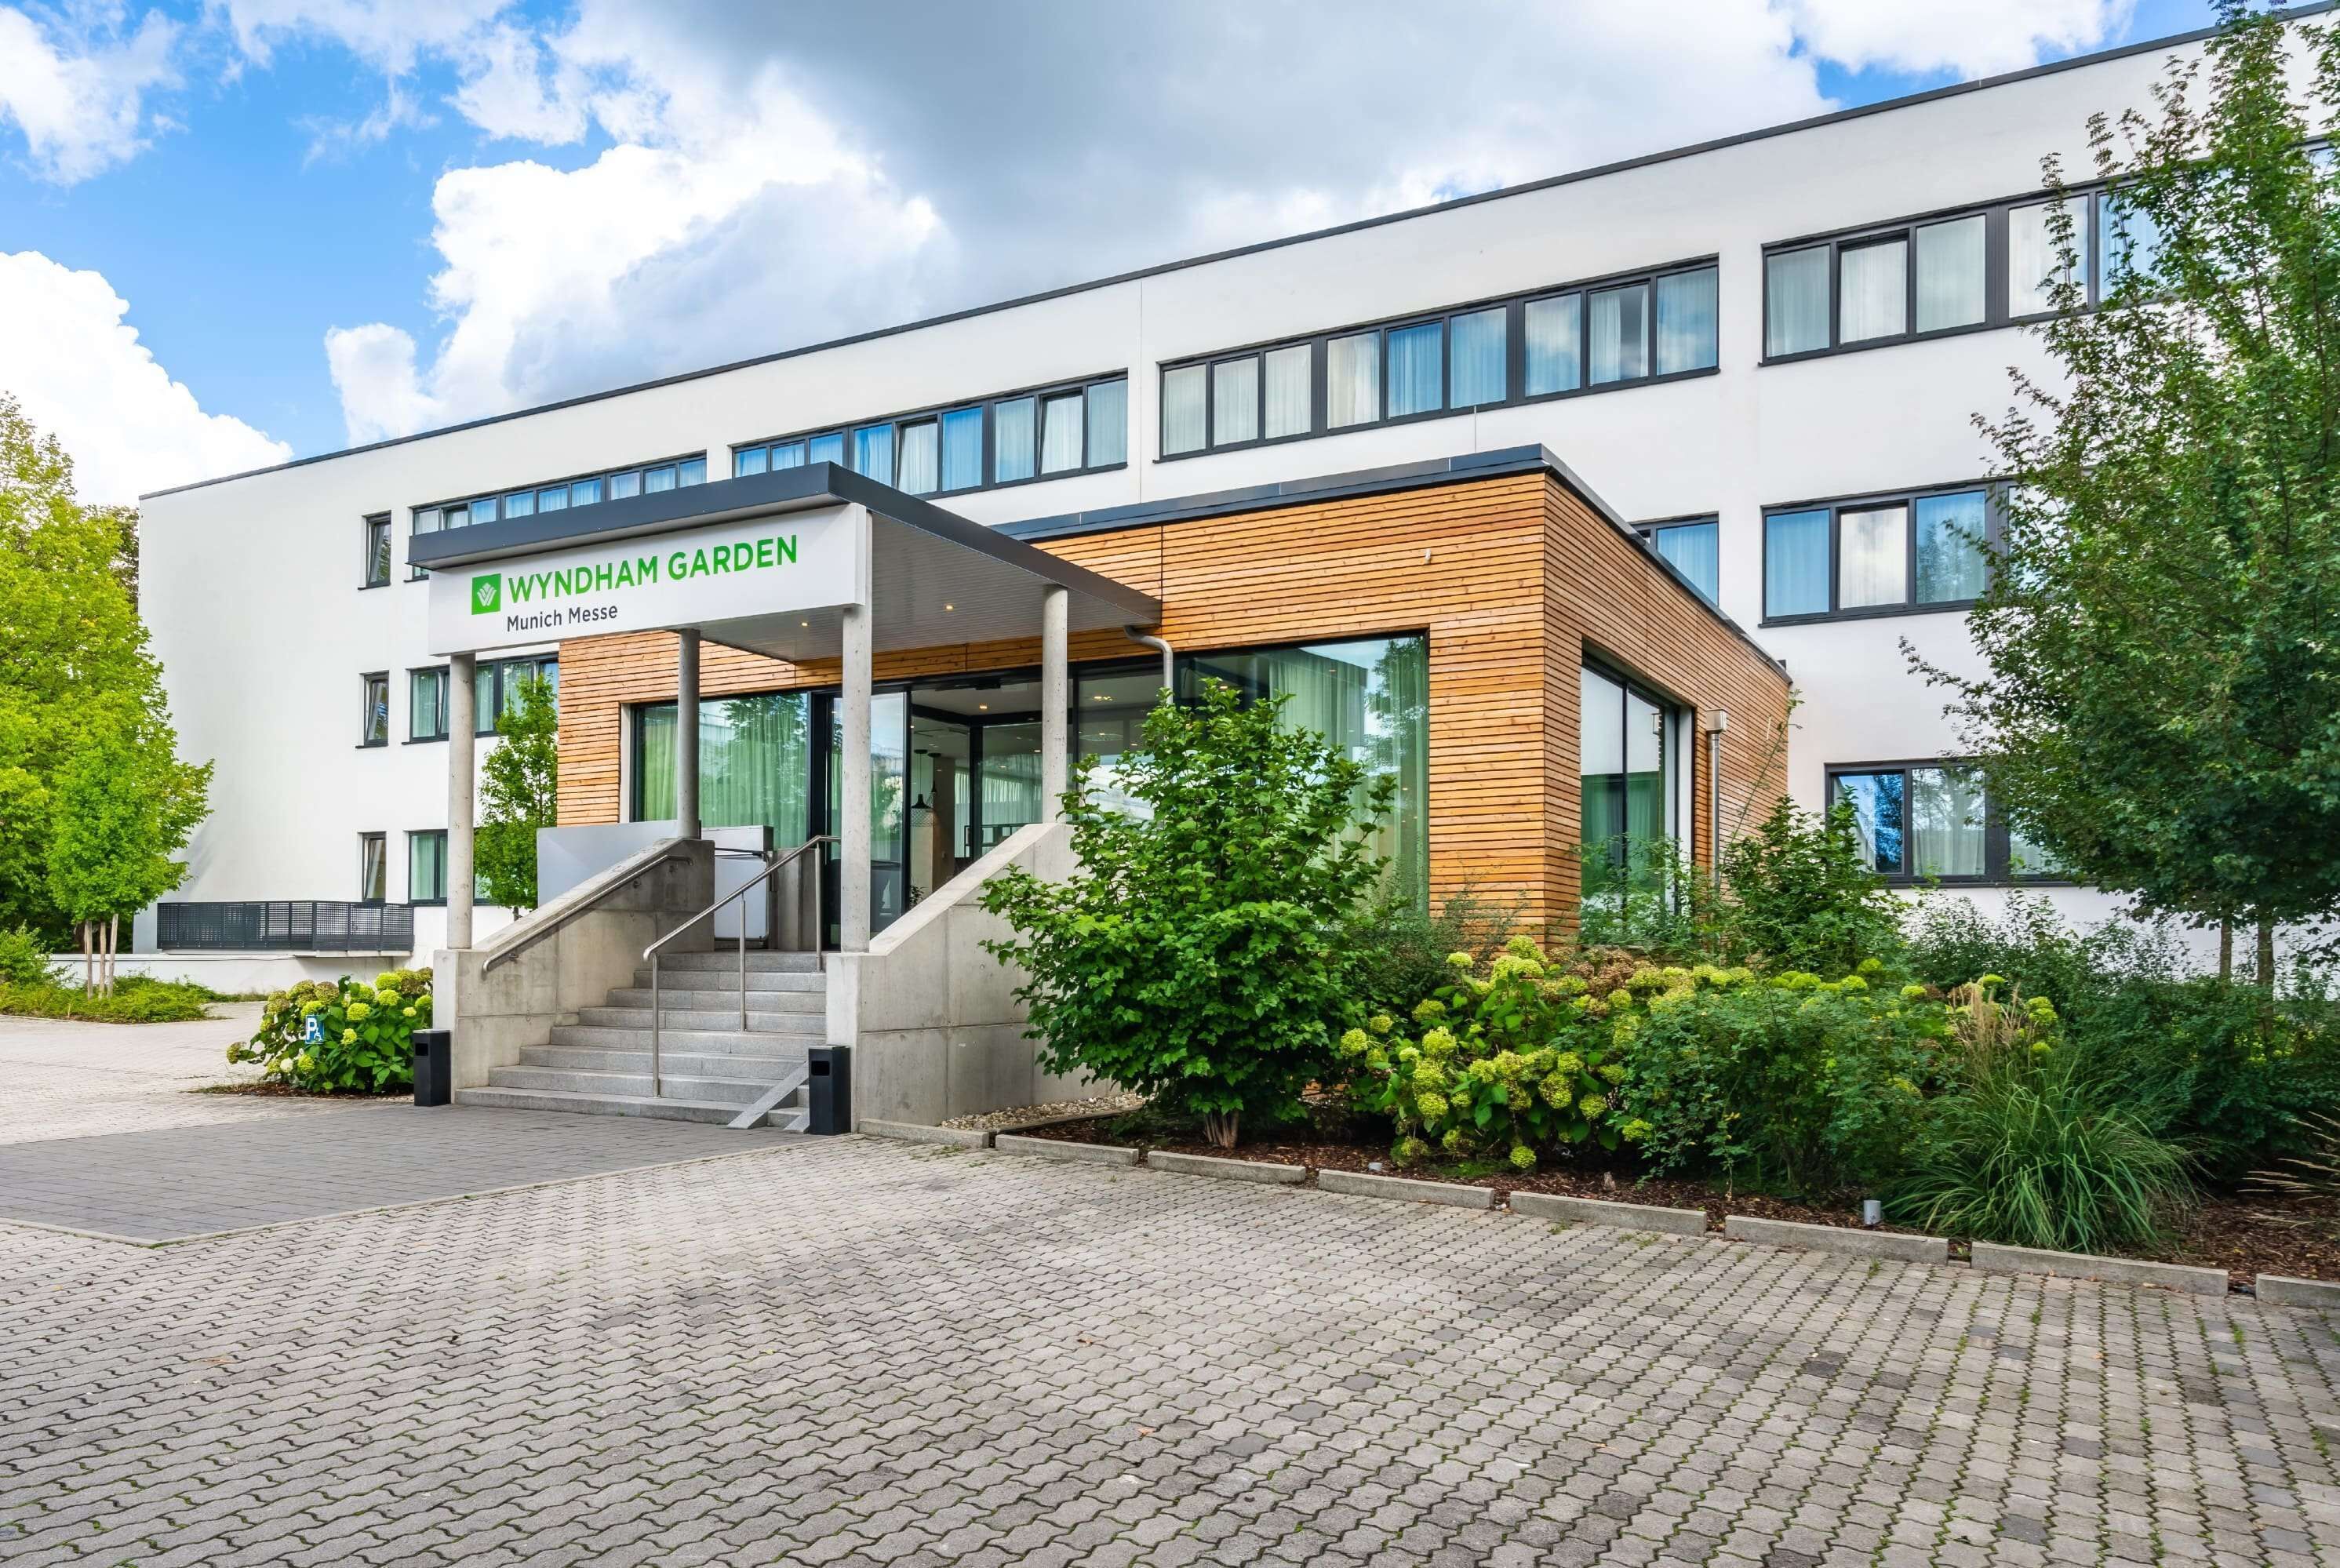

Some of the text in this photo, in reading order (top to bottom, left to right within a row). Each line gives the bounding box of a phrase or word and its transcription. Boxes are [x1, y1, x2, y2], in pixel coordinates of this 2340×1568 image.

[508, 534, 798, 603] WYNDHAM GARDEN
[507, 605, 618, 631] Munich Messe
[307, 1017, 317, 1040] P
